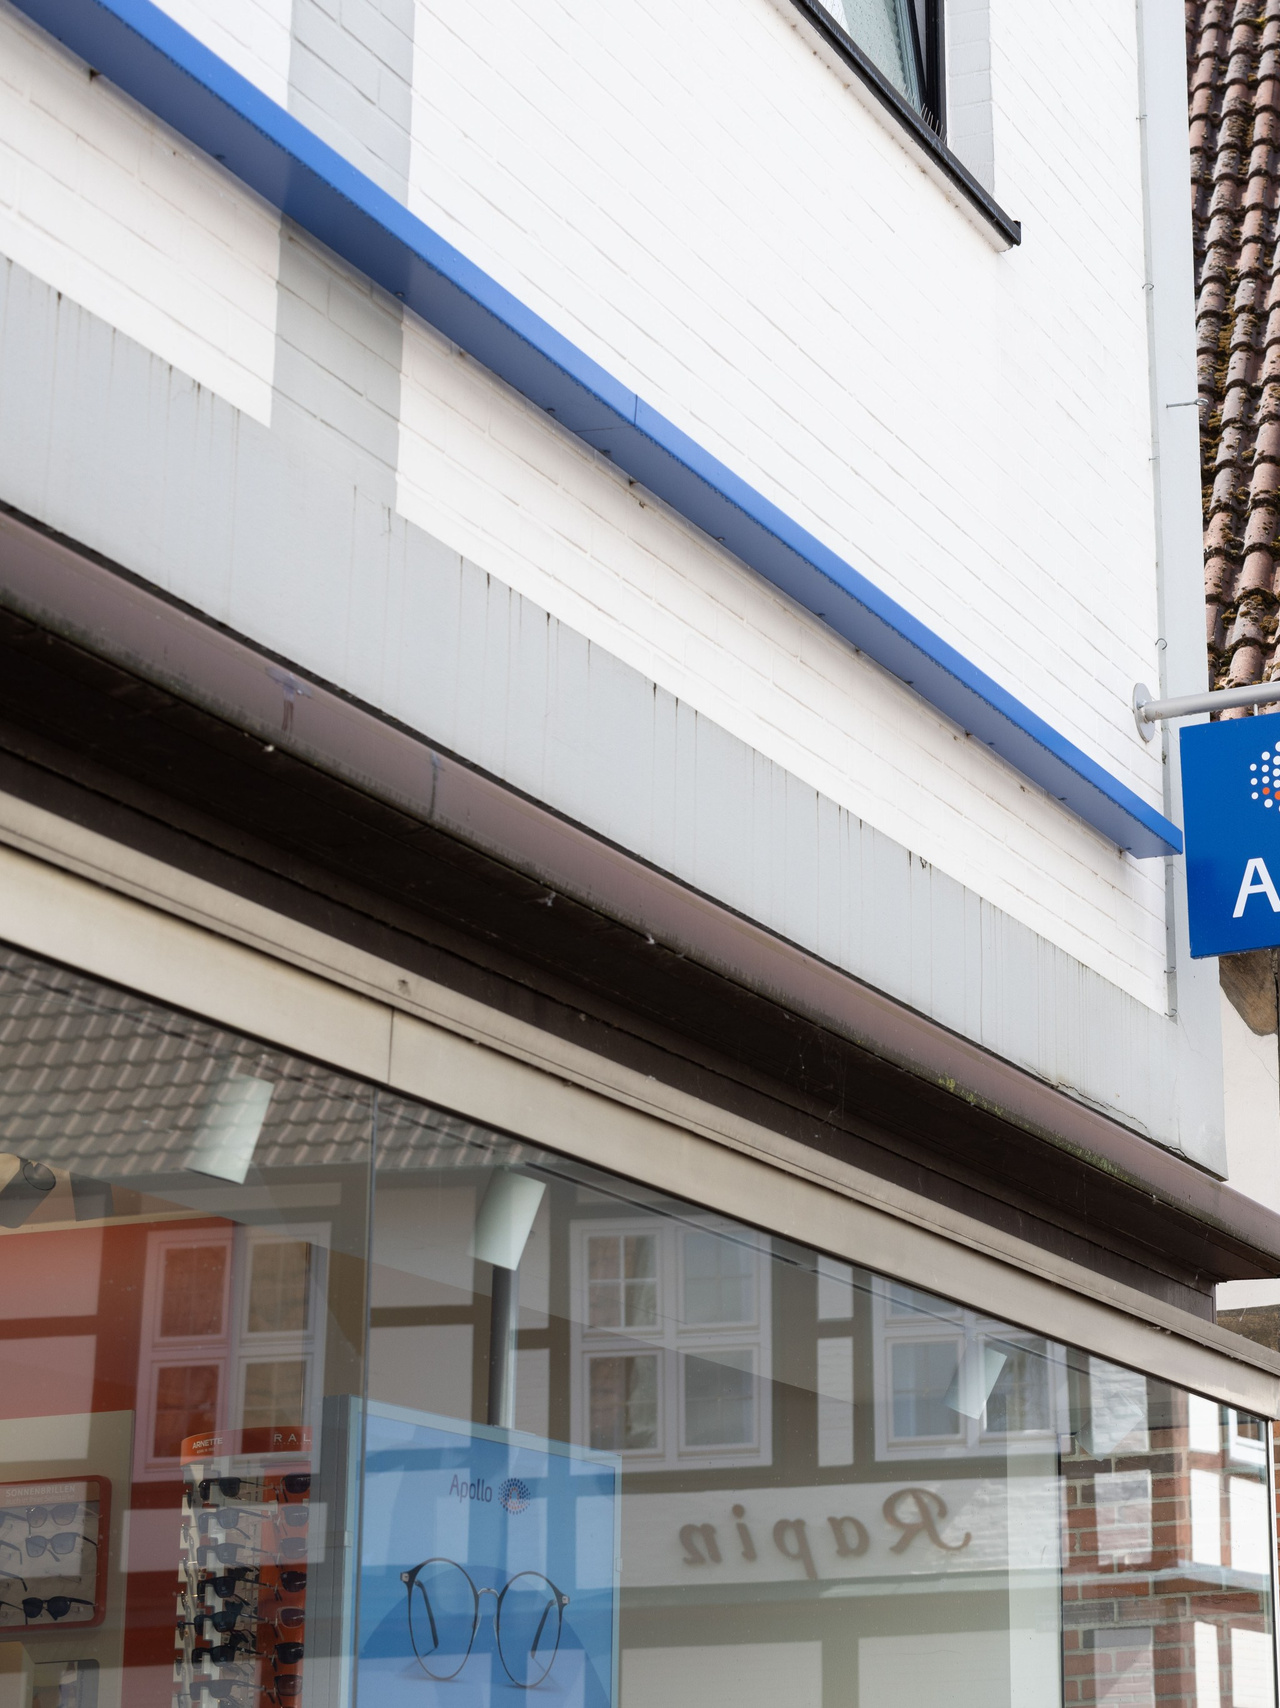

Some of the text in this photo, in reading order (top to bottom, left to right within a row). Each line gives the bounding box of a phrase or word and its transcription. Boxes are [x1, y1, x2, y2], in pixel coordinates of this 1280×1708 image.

[192, 1437, 224, 1450] ARNETTE
[5, 1484, 76, 1498] SONNENBRILLEN
[450, 1474, 493, 1503] Apollo
